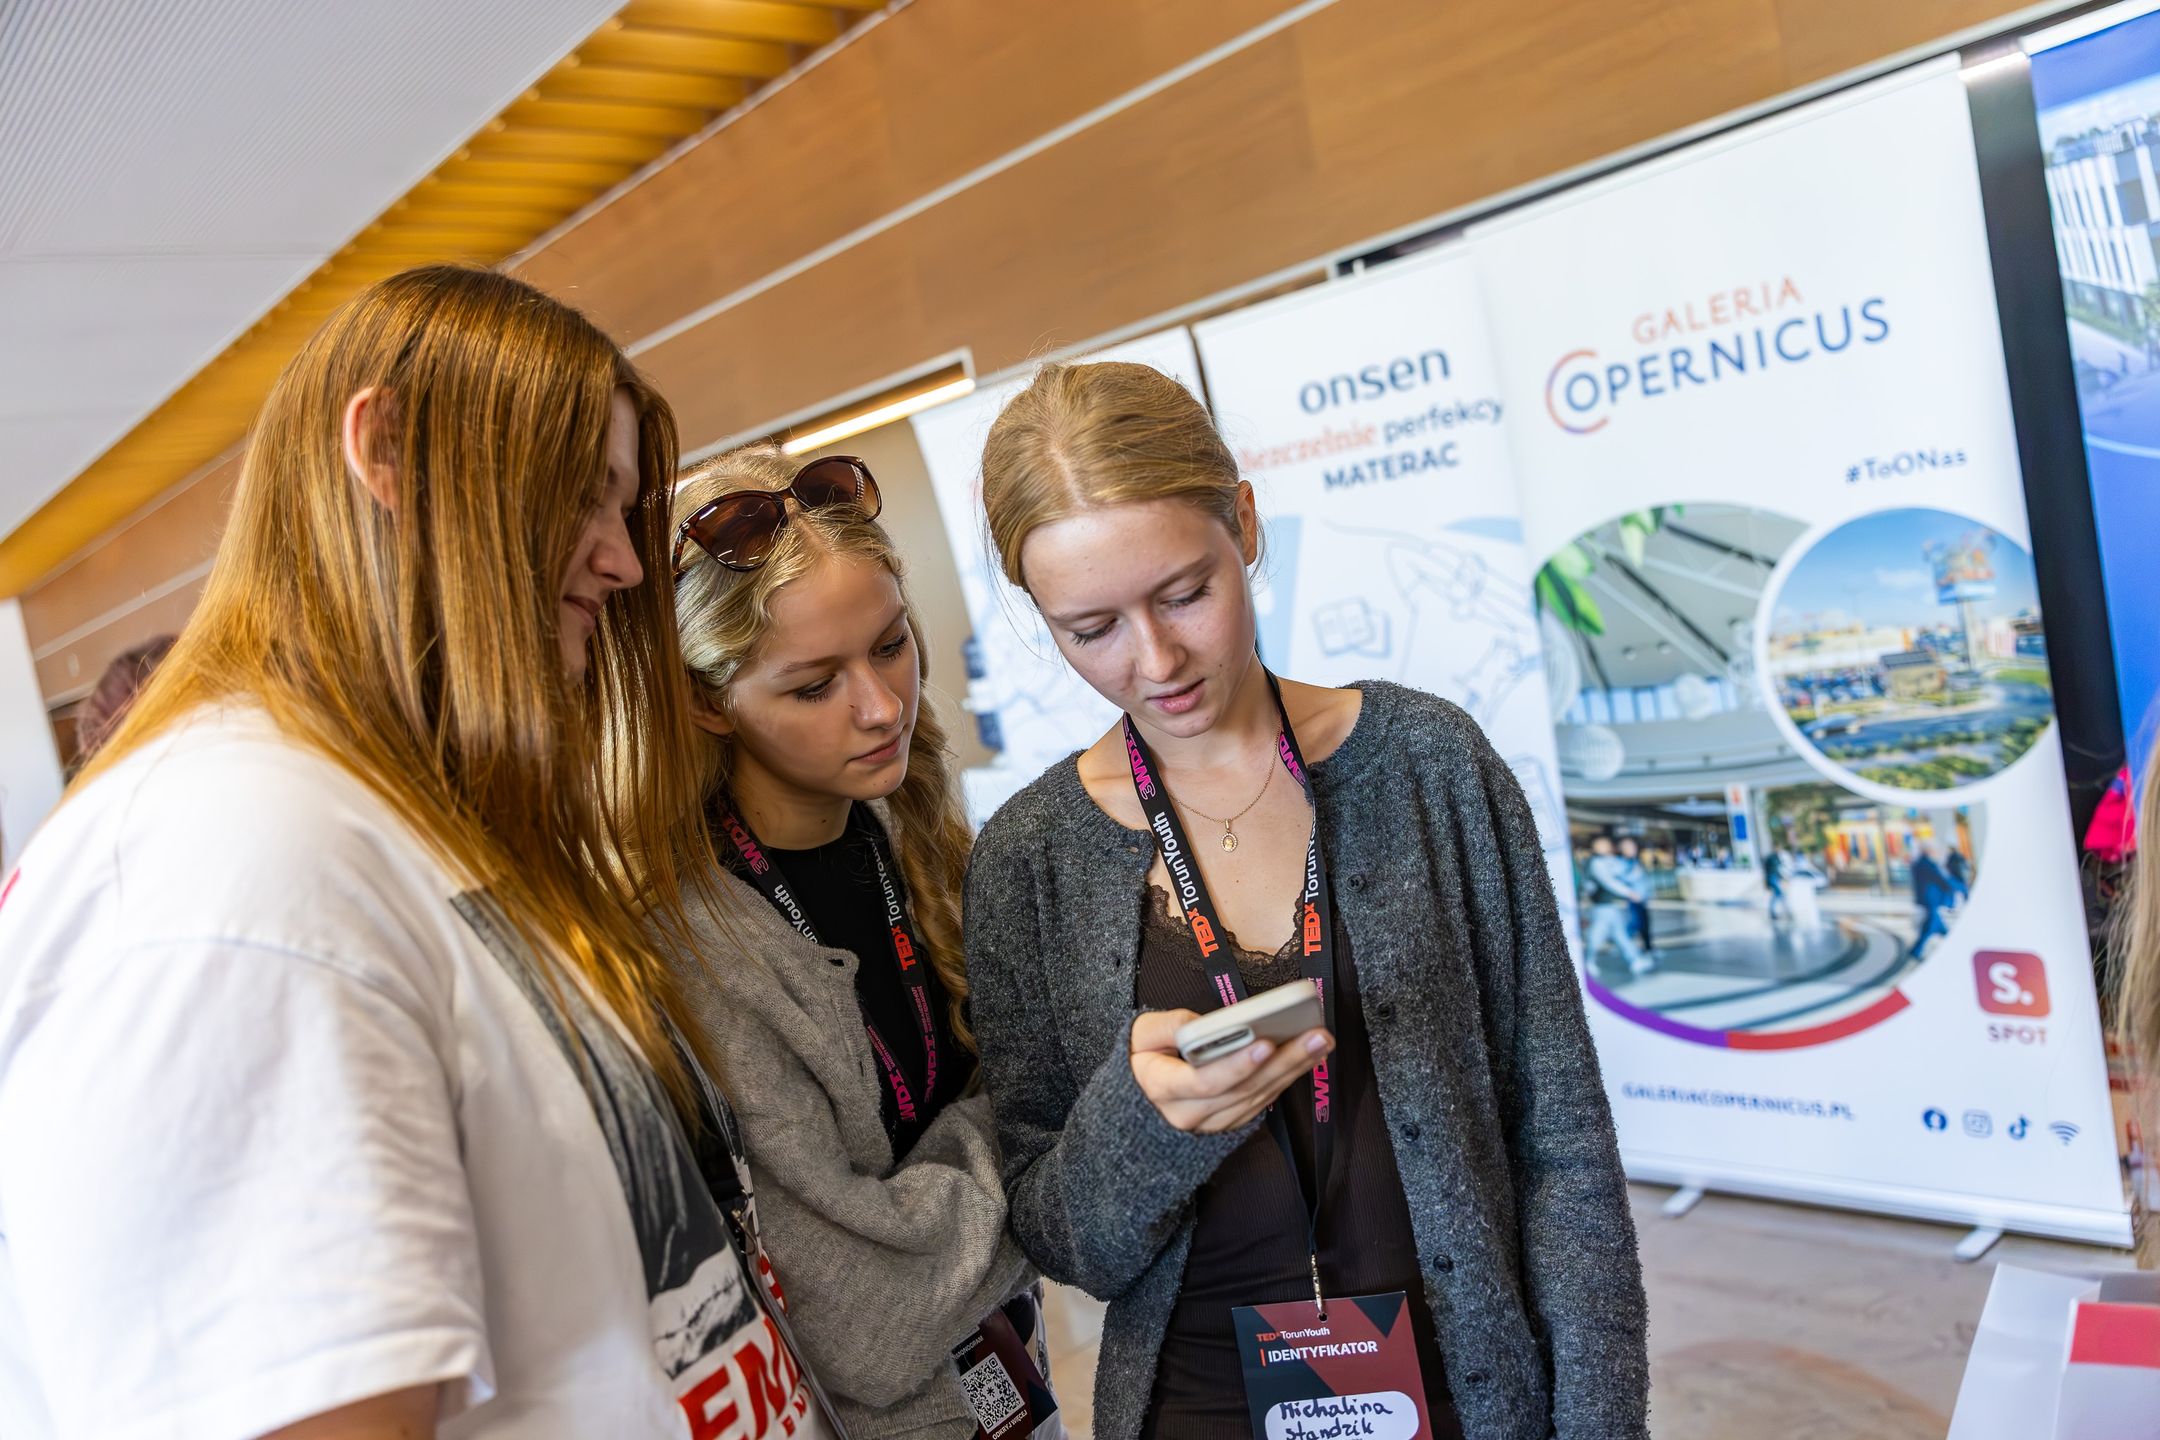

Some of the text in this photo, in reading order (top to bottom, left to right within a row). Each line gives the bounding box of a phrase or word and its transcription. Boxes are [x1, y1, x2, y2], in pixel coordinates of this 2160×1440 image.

[1632, 276, 1804, 344] GALERIA
[1299, 348, 1451, 415] onsen
[1545, 298, 1890, 434] COPERNICUS
[1323, 443, 1459, 491] MATERAC
[1988, 1024, 2047, 1046] SPOT
[1268, 1340, 1378, 1363] IDENTYFIKATOR
[1279, 1396, 1394, 1421] Michalina
